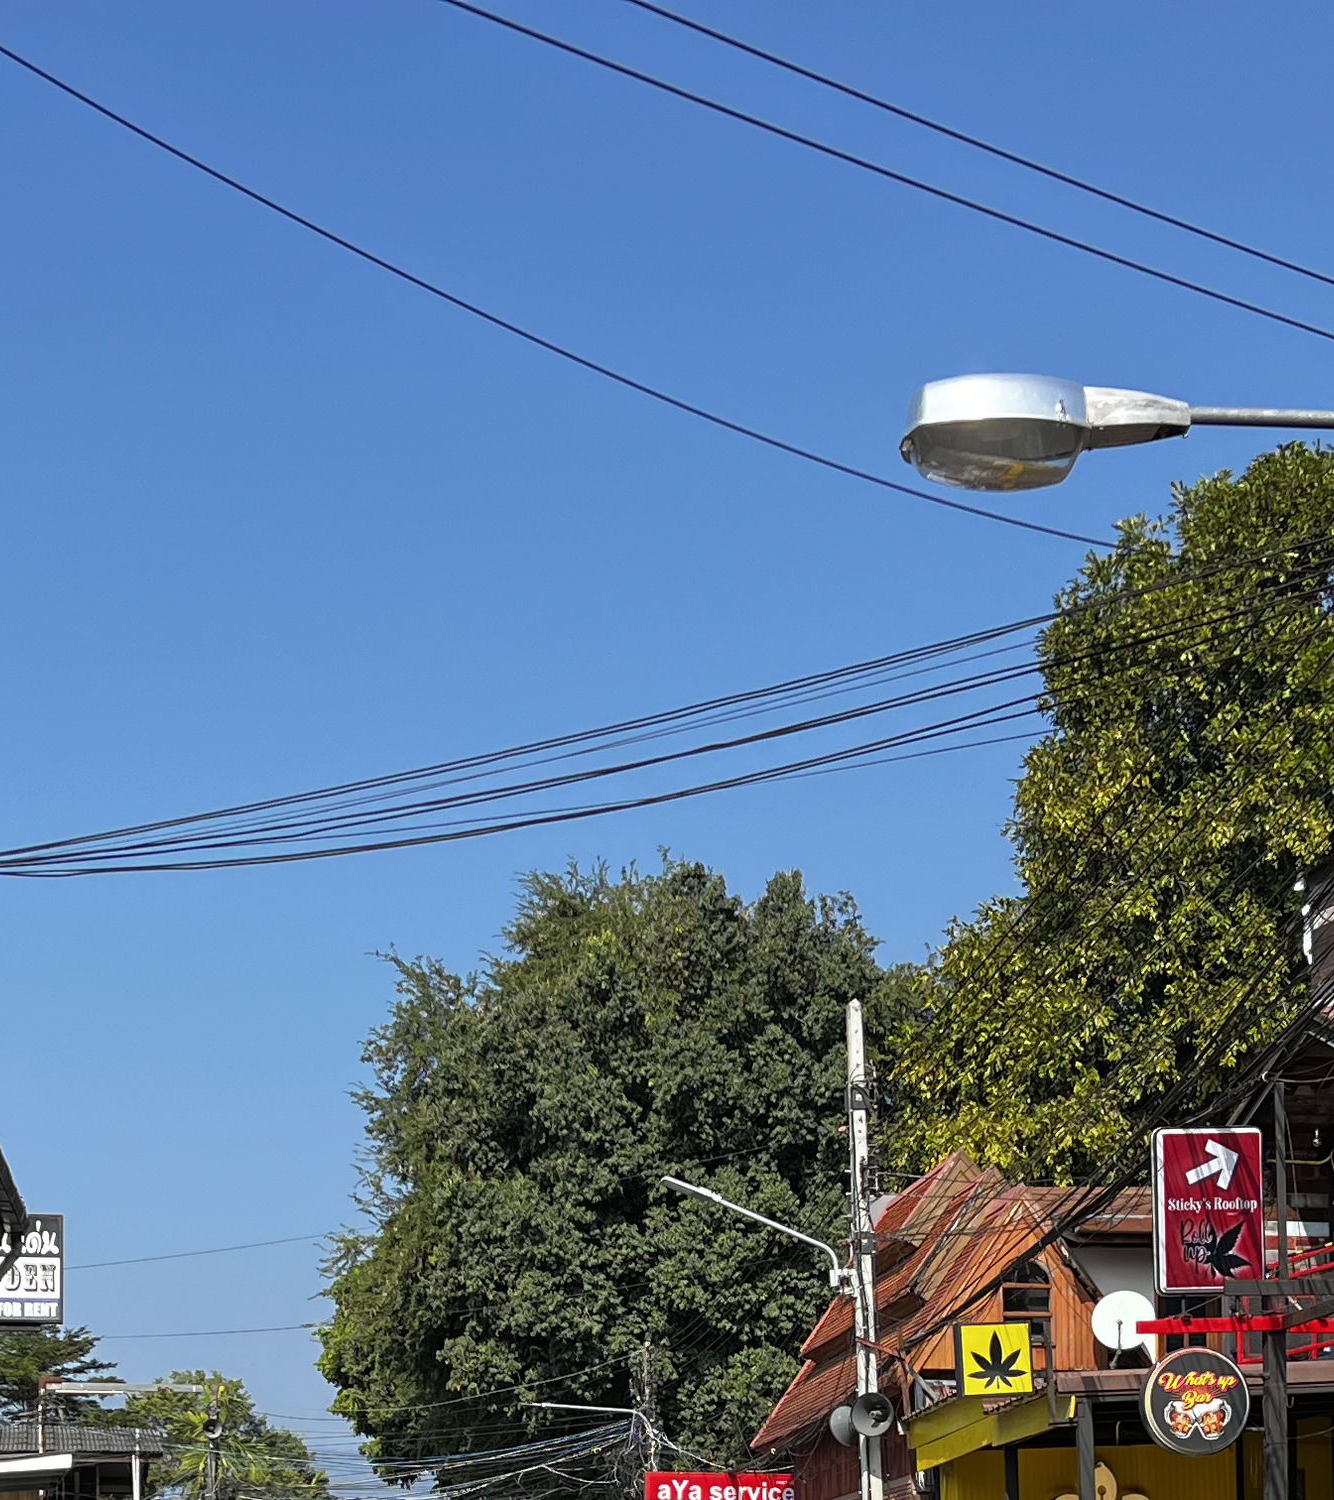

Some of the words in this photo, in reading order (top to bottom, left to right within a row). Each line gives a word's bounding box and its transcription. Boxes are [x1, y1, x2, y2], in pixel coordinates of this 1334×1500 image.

[1168, 1197, 1212, 1213] Sticky's
[1214, 1197, 1258, 1213] Rooftop
[24, 1302, 58, 1317] RENT
[1180, 1389, 1214, 1411] Bar
[657, 1480, 702, 1500] aYa
